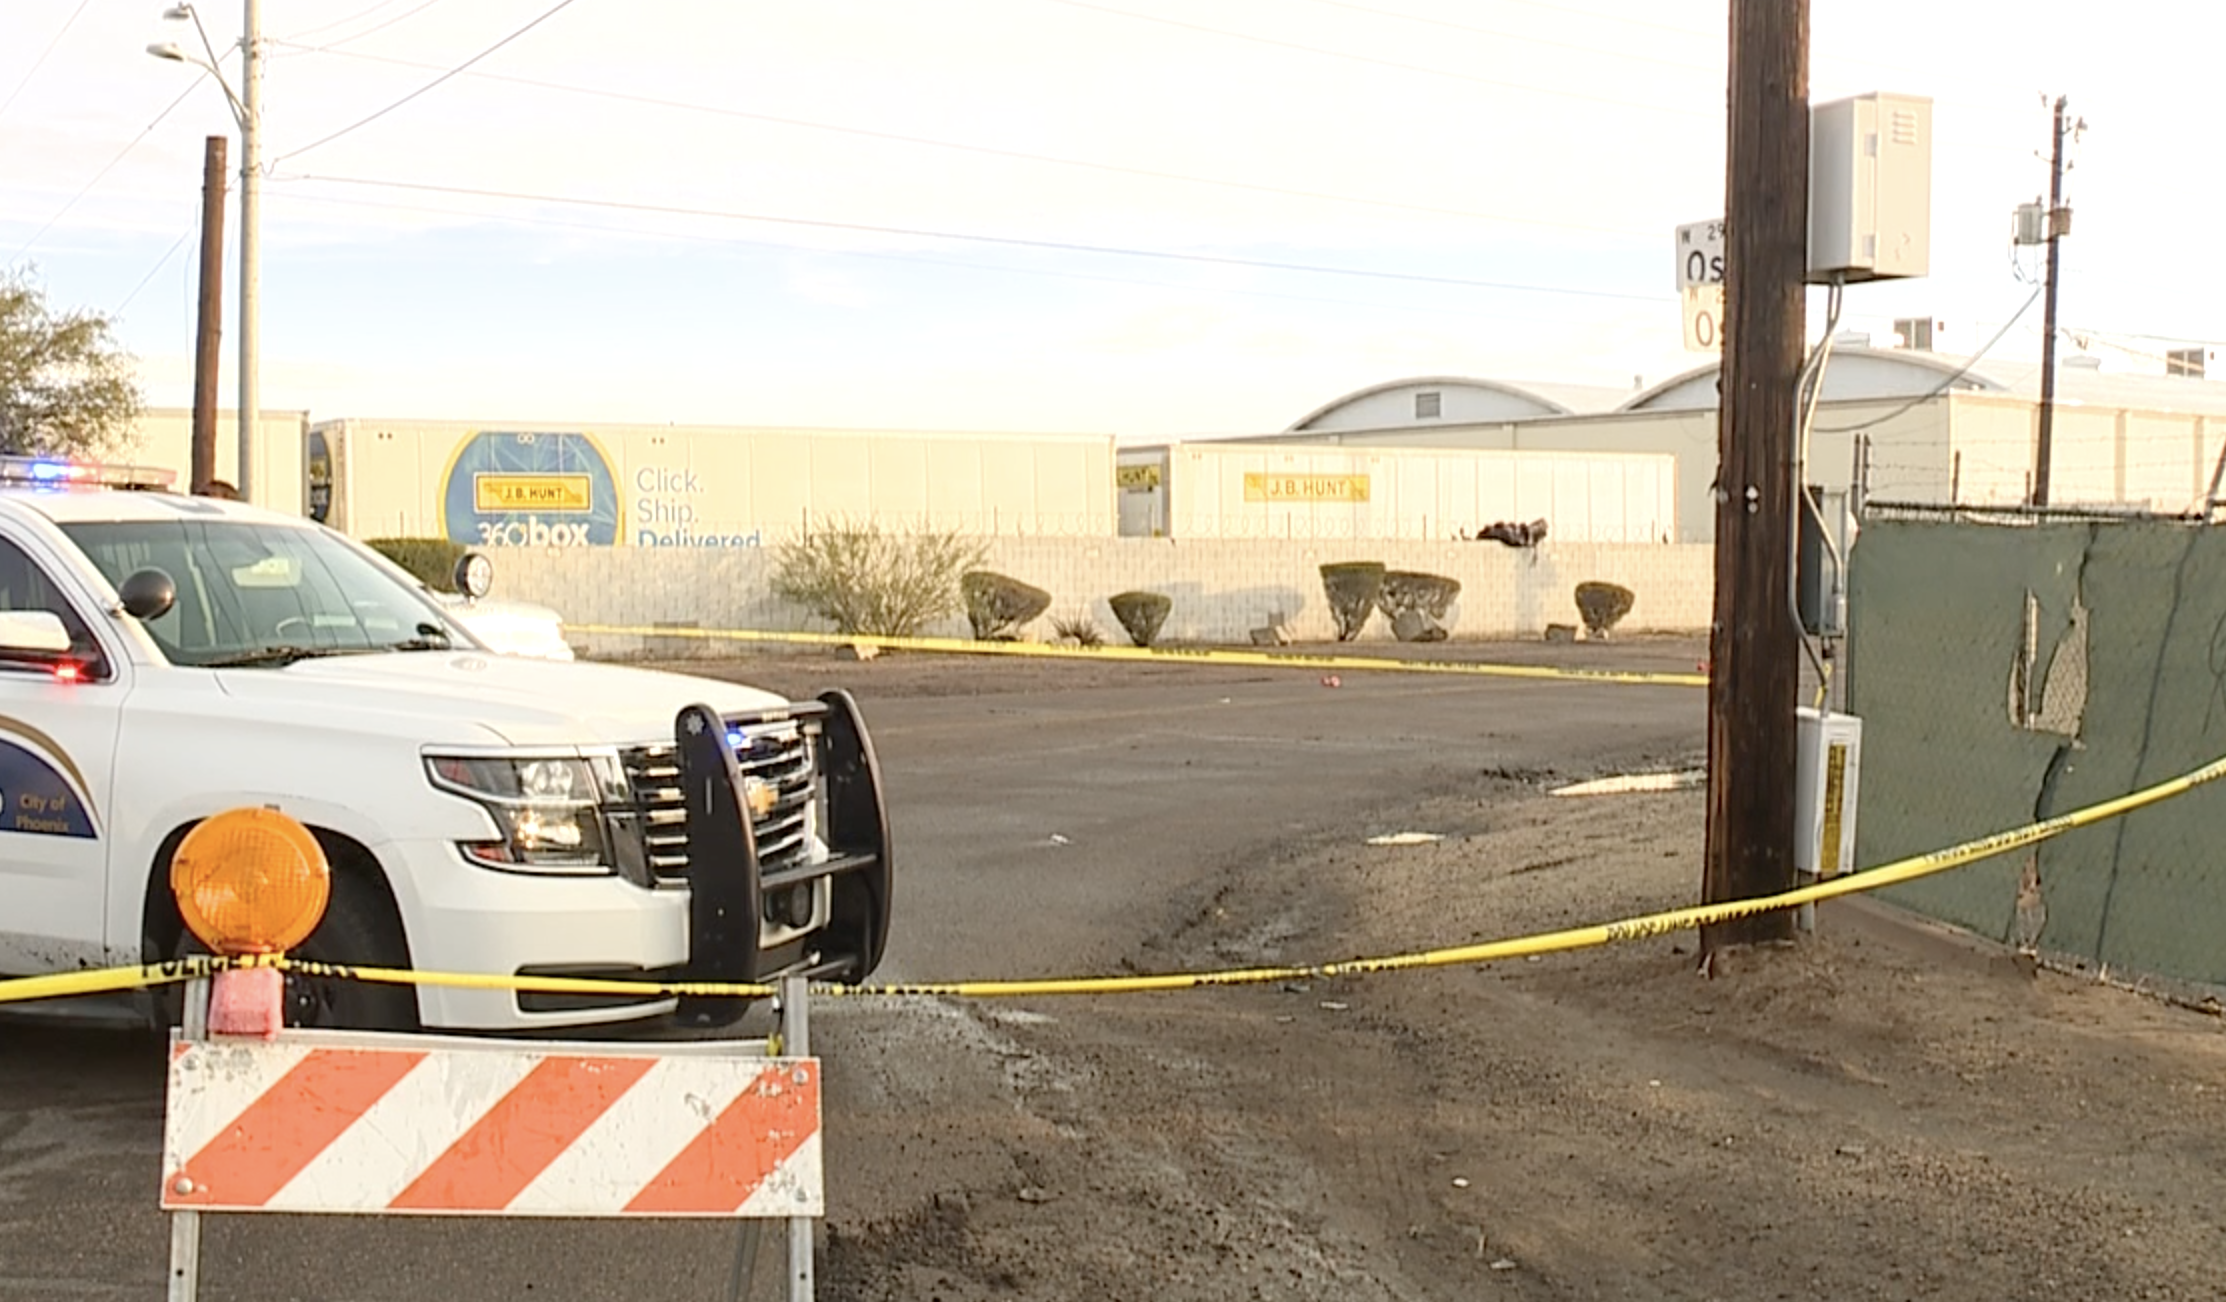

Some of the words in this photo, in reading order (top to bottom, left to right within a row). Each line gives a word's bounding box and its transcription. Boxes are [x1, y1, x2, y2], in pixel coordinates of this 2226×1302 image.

[637, 467, 704, 493] Click.
[1303, 479, 1346, 496] HUNT
[530, 487, 563, 500] HUNT
[638, 498, 699, 528] Ship.
[20, 793, 46, 813] City
[50, 794, 66, 811] of
[16, 815, 70, 832] Phoenix
